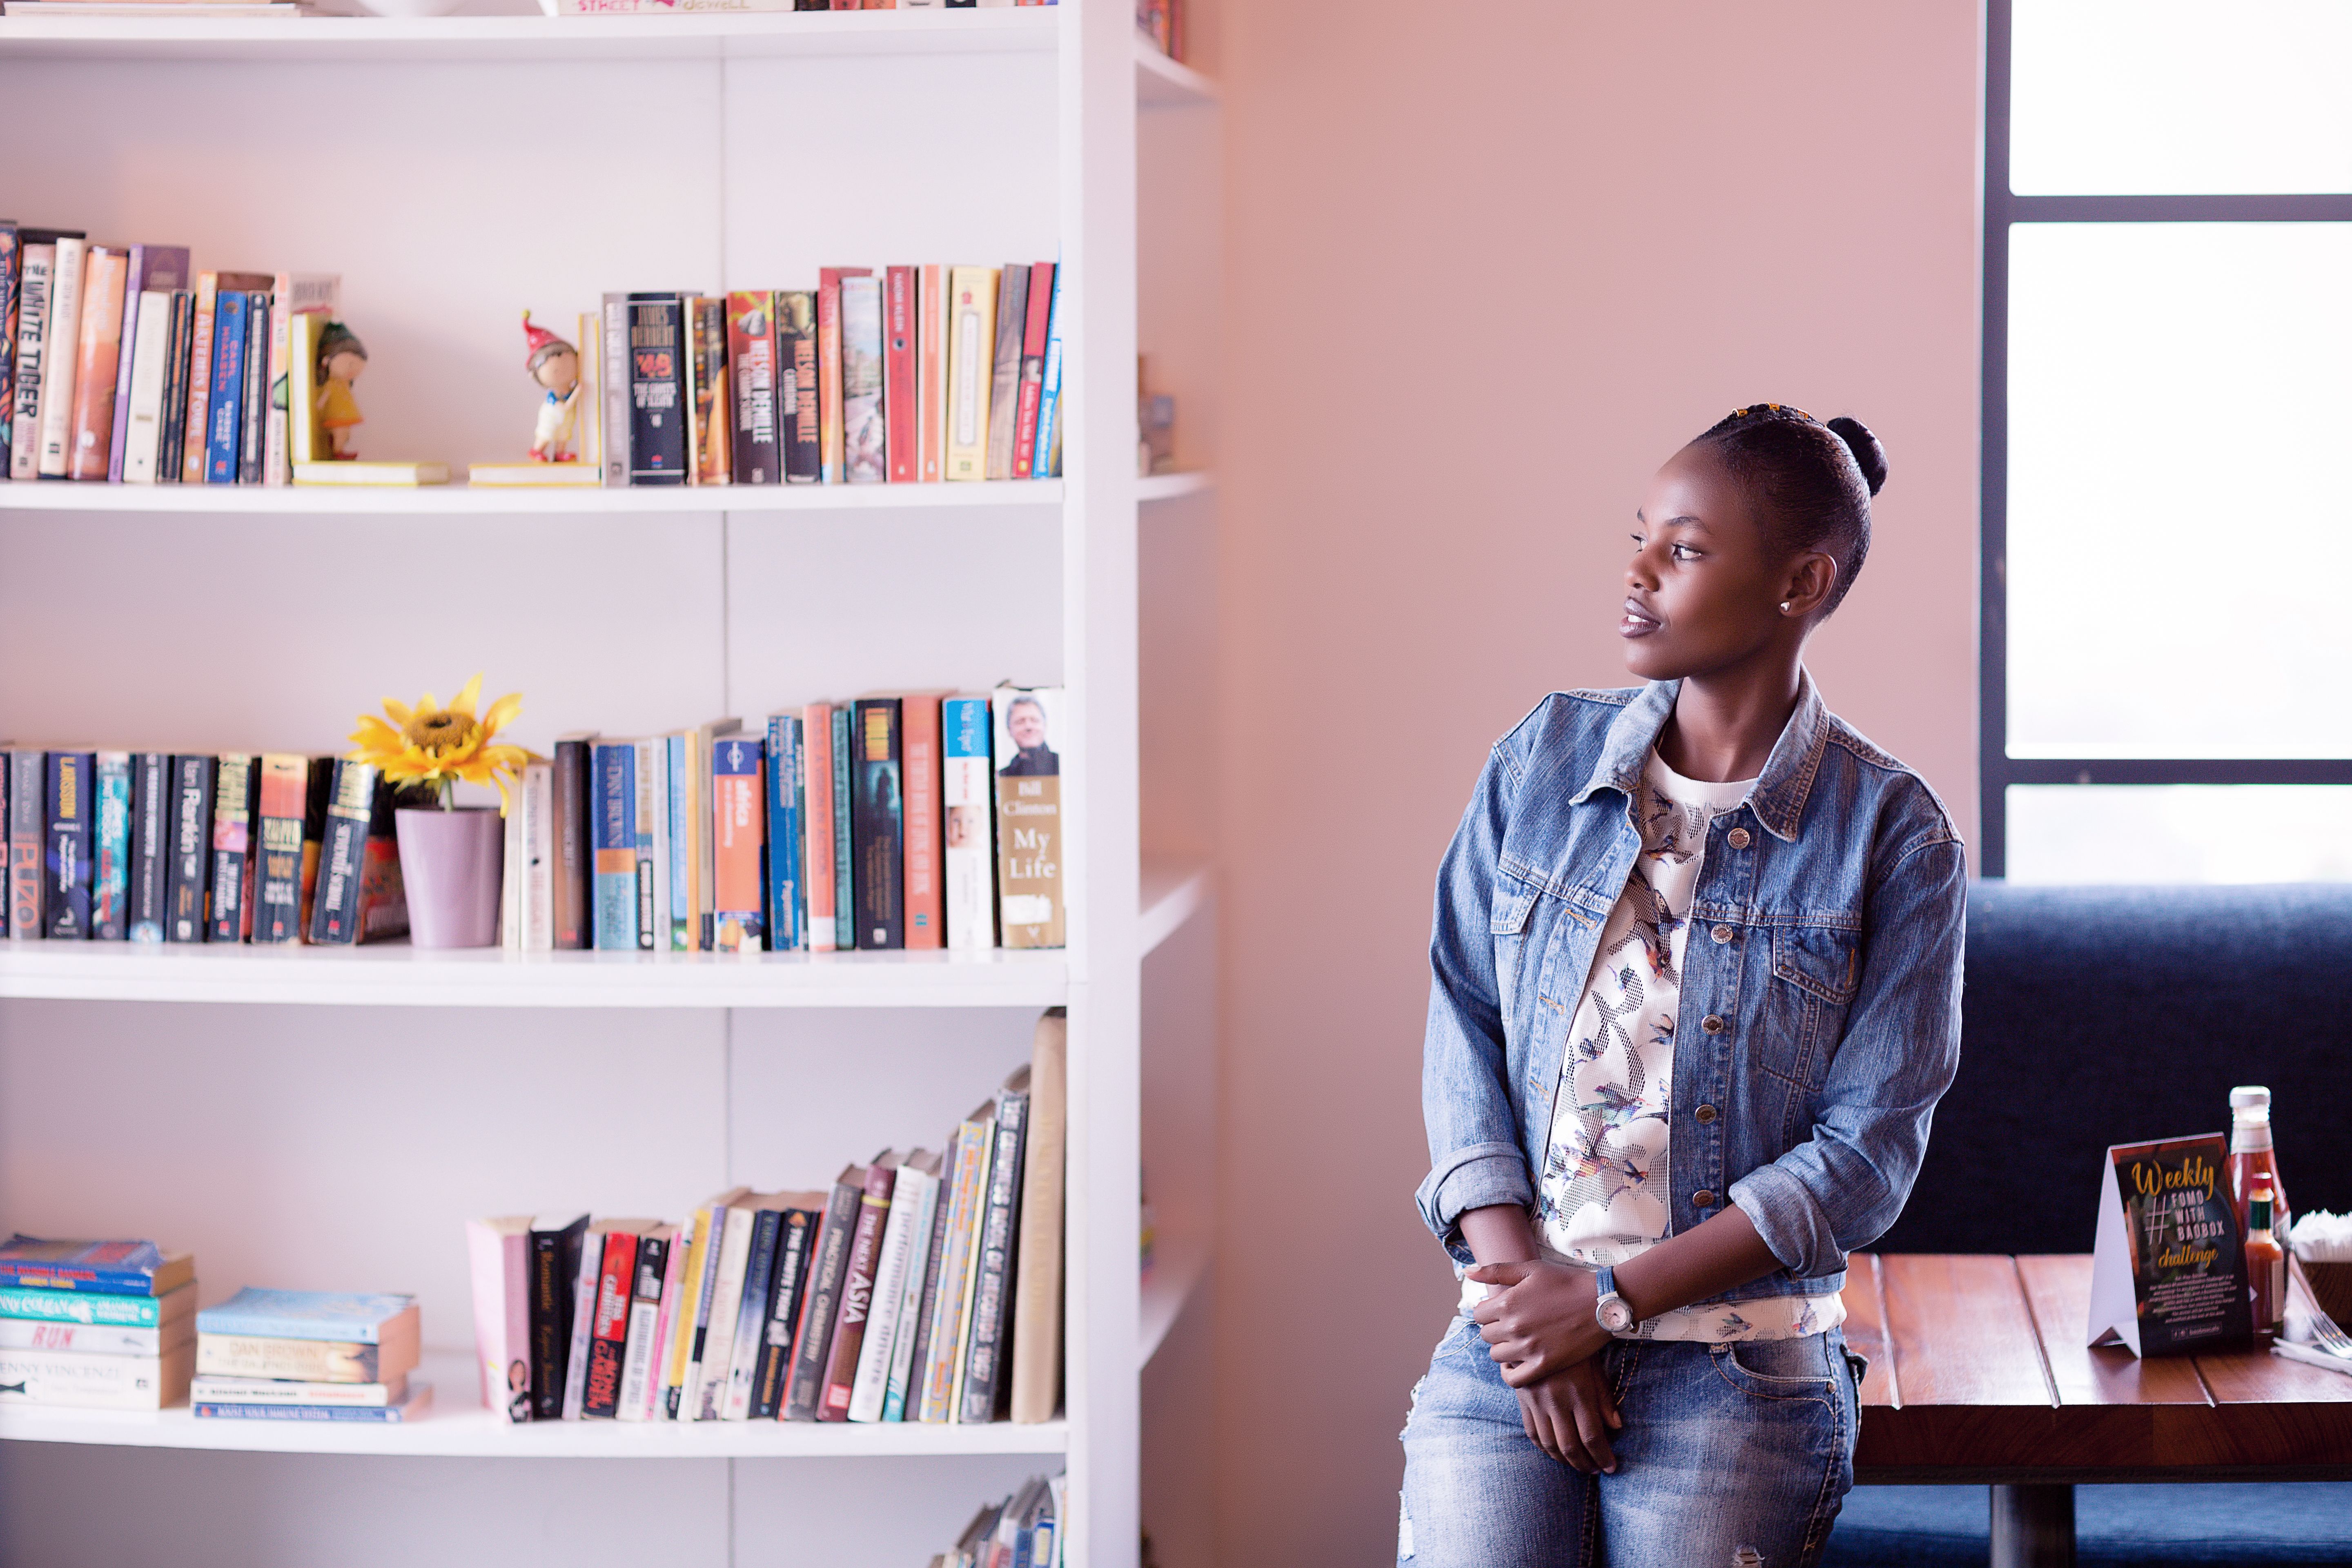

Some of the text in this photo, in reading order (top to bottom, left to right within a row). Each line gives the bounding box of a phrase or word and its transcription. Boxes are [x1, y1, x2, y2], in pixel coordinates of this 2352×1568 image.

[20, 280, 46, 343] WHITE
[18, 348, 41, 418] TIGER
[751, 340, 771, 388] NELSON
[795, 340, 815, 388] NELSON
[180, 760, 201, 853] Ian Rankin
[735, 780, 752, 826] africa
[1003, 802, 1057, 817] Clinton
[1018, 780, 1042, 797] Bill
[1013, 828, 1051, 860] My
[12, 843, 39, 929] PUZO
[1009, 857, 1057, 879] Life
[2131, 1155, 2214, 1201] Weekly
[2171, 1189, 2204, 1207] FOMO
[2175, 1205, 2205, 1224] WITH
[2177, 1220, 2225, 1242] BAOBOX
[844, 1213, 876, 1324] THE NEXT ASIA
[2158, 1244, 2218, 1268] challenge
[806, 1227, 844, 1362] PRACTICAL CHEMISTRY
[32, 1325, 75, 1348] RUN
